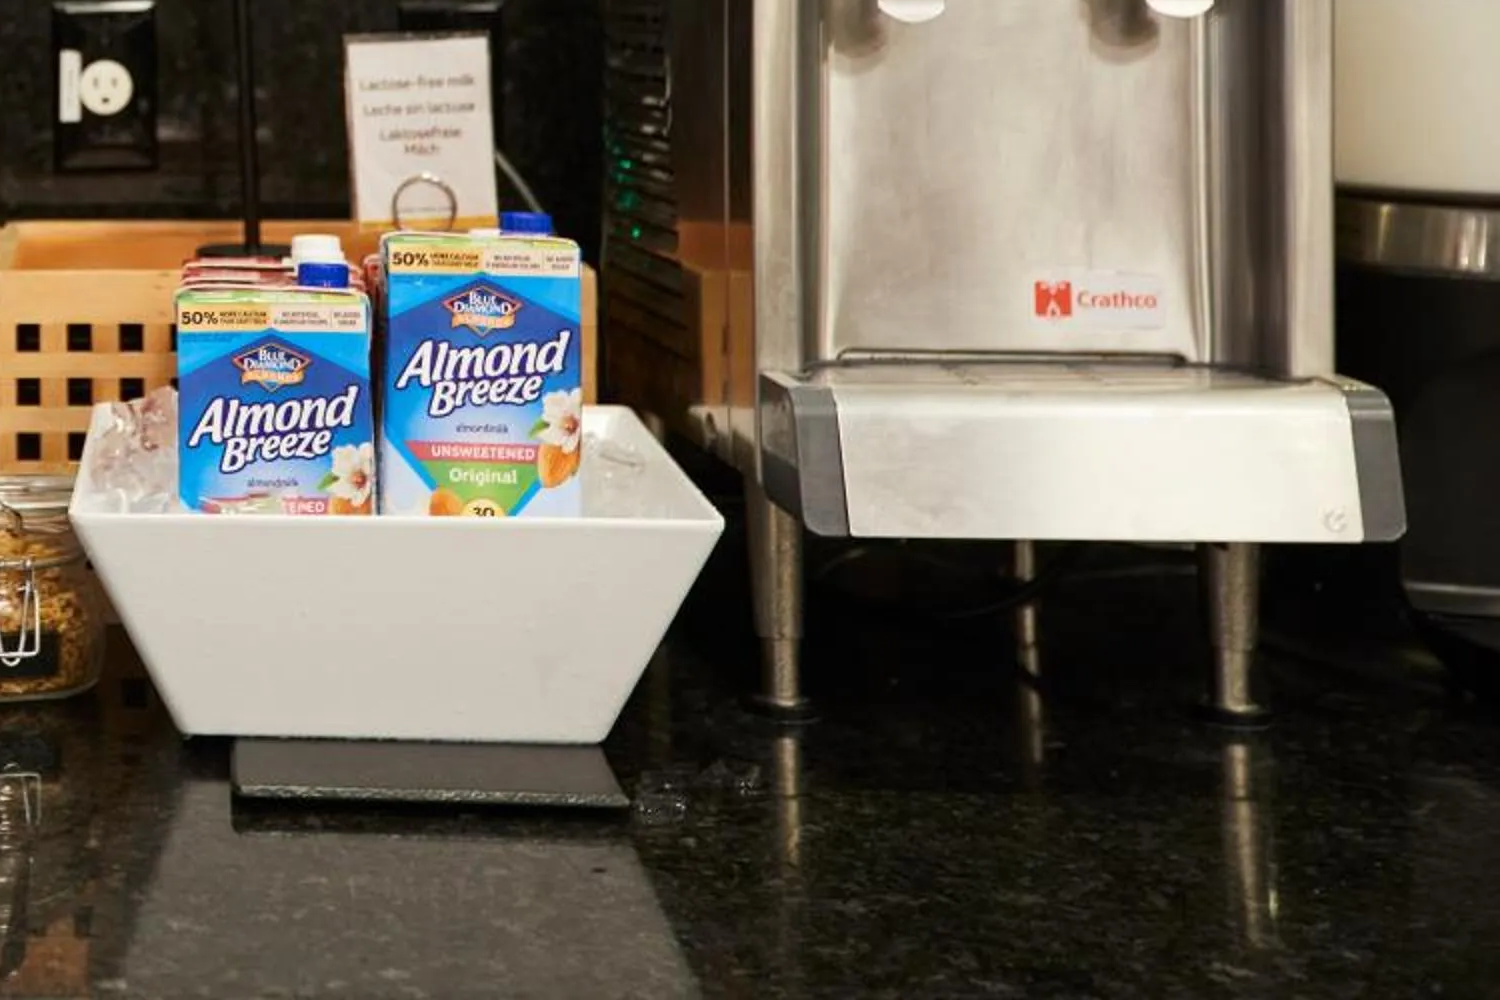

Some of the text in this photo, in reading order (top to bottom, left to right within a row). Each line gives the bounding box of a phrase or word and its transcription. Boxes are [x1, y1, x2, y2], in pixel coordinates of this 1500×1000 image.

[392, 252, 429, 267] 50%
[1077, 291, 1158, 308] Crathco
[181, 311, 219, 326] 50%
[396, 330, 571, 389] Almond
[429, 374, 543, 417] Breeze
[189, 386, 358, 446] Almond
[221, 429, 331, 473] Breeze
[431, 444, 535, 460] UNSWEETENED
[449, 467, 518, 487] Original
